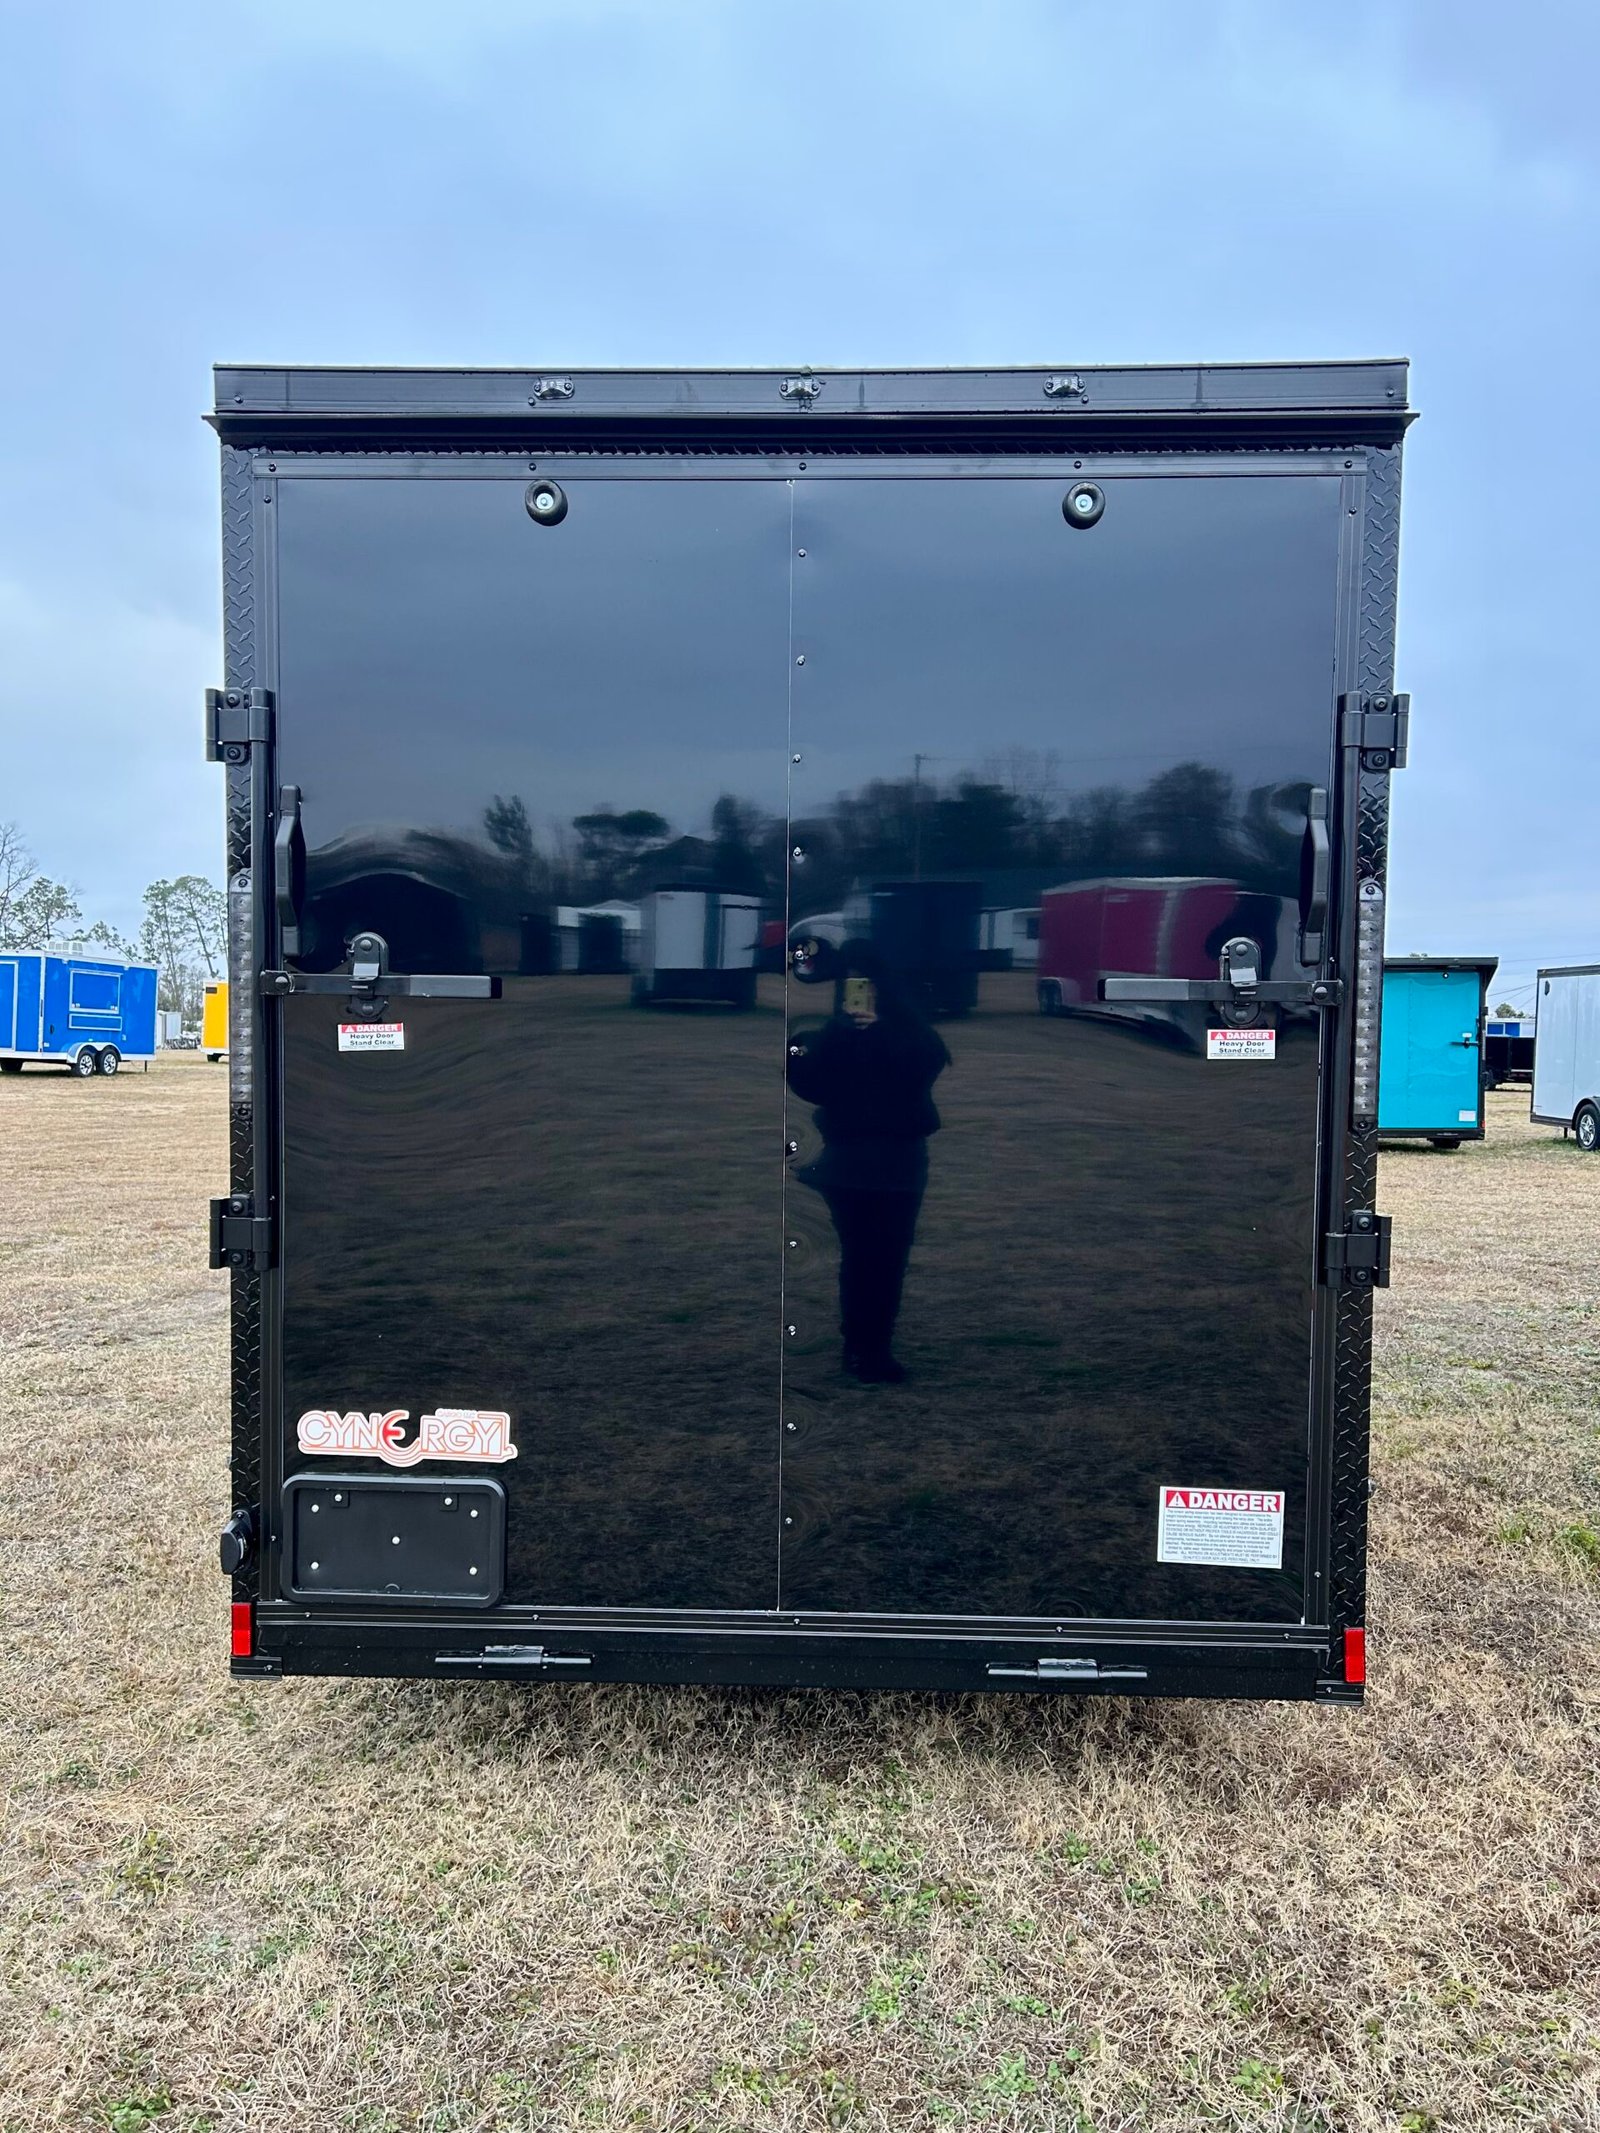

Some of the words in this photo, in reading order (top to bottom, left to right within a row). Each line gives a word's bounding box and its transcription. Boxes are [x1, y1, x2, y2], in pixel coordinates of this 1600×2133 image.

[356, 1024, 398, 1032] DANGER
[1226, 1032, 1270, 1040] DANGER
[298, 1410, 502, 1457] CYNERGY
[1188, 1492, 1278, 1512] DANGER
